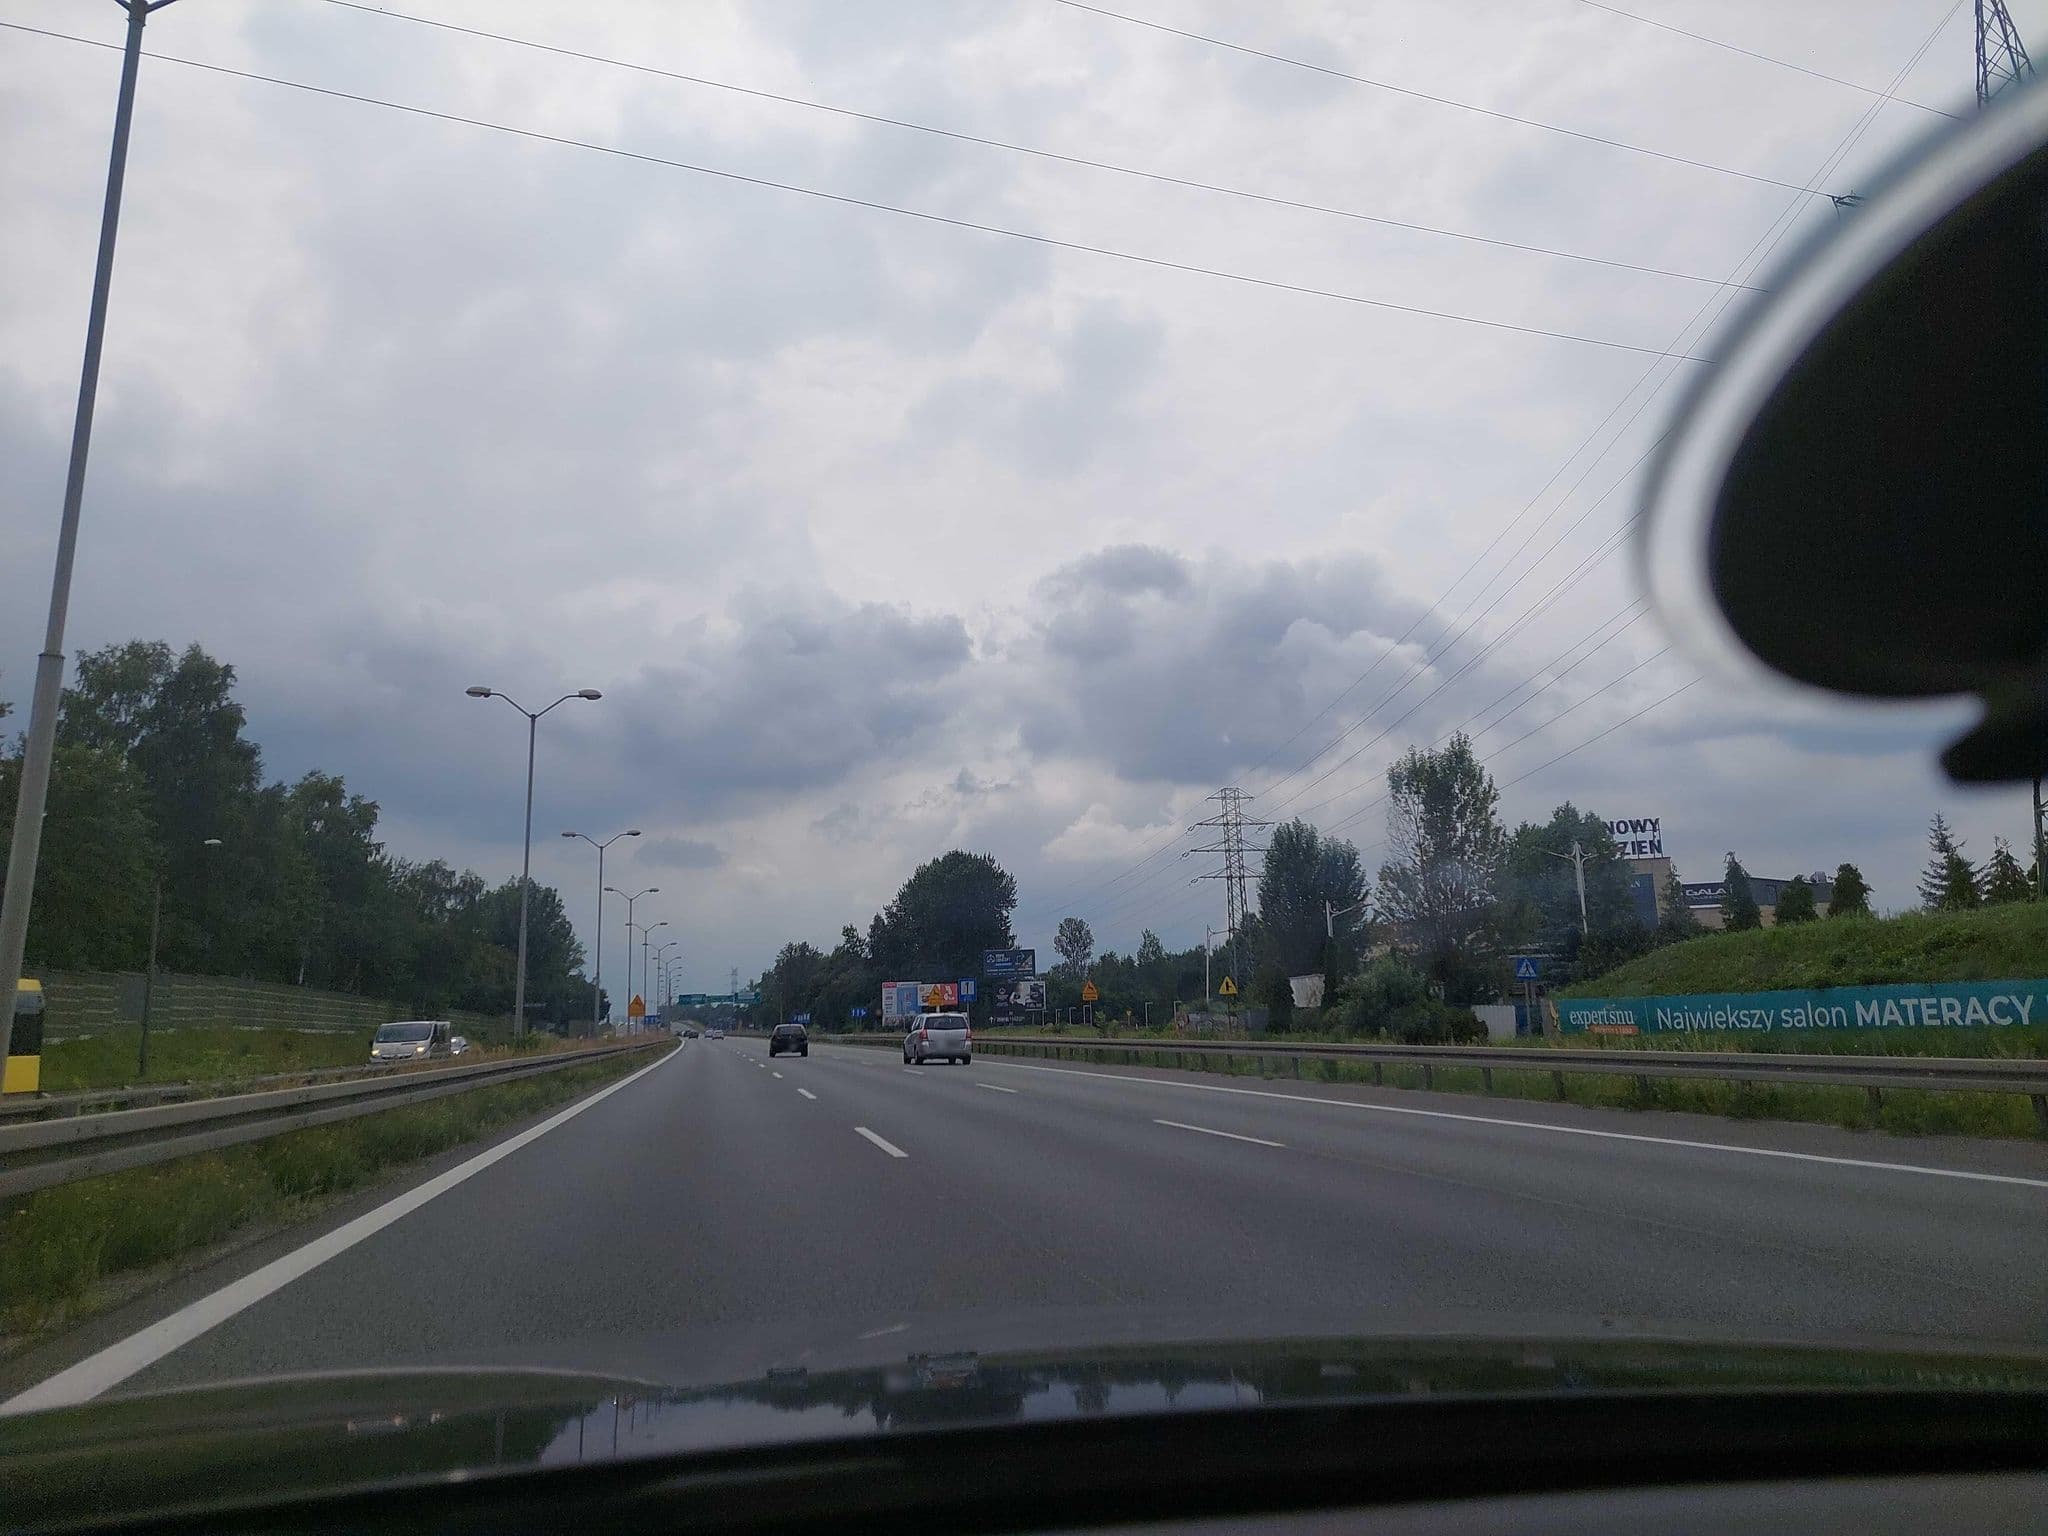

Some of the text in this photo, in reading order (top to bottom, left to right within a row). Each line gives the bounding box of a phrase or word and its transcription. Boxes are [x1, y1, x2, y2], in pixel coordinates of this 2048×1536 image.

[1603, 818, 1660, 835] NOWY
[1685, 888, 1727, 896] GALA
[1781, 1001, 1848, 1028] salon
[1855, 994, 2034, 1026] MATERACY
